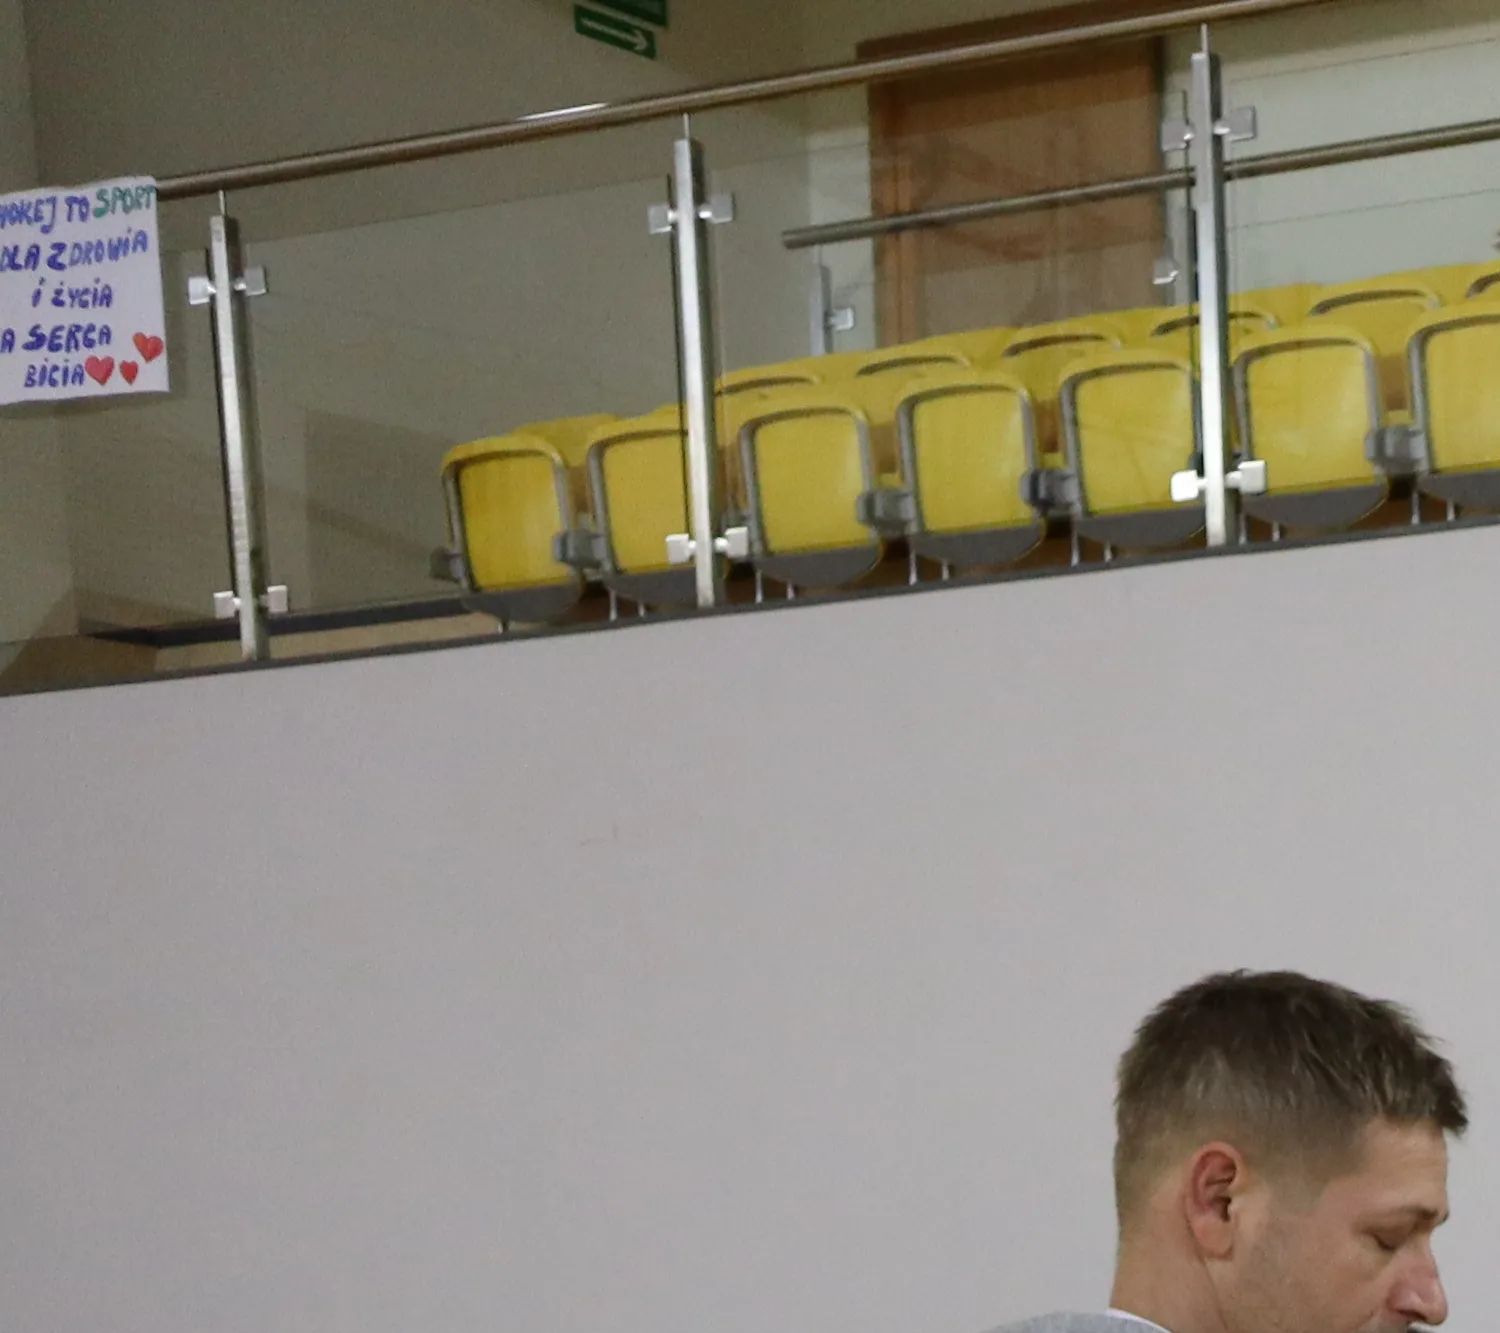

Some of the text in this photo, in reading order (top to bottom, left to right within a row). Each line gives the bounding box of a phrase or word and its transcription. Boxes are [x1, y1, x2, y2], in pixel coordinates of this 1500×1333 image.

[64, 195, 90, 223] TO
[93, 184, 158, 218] SPORT
[22, 323, 112, 353] SERCA
